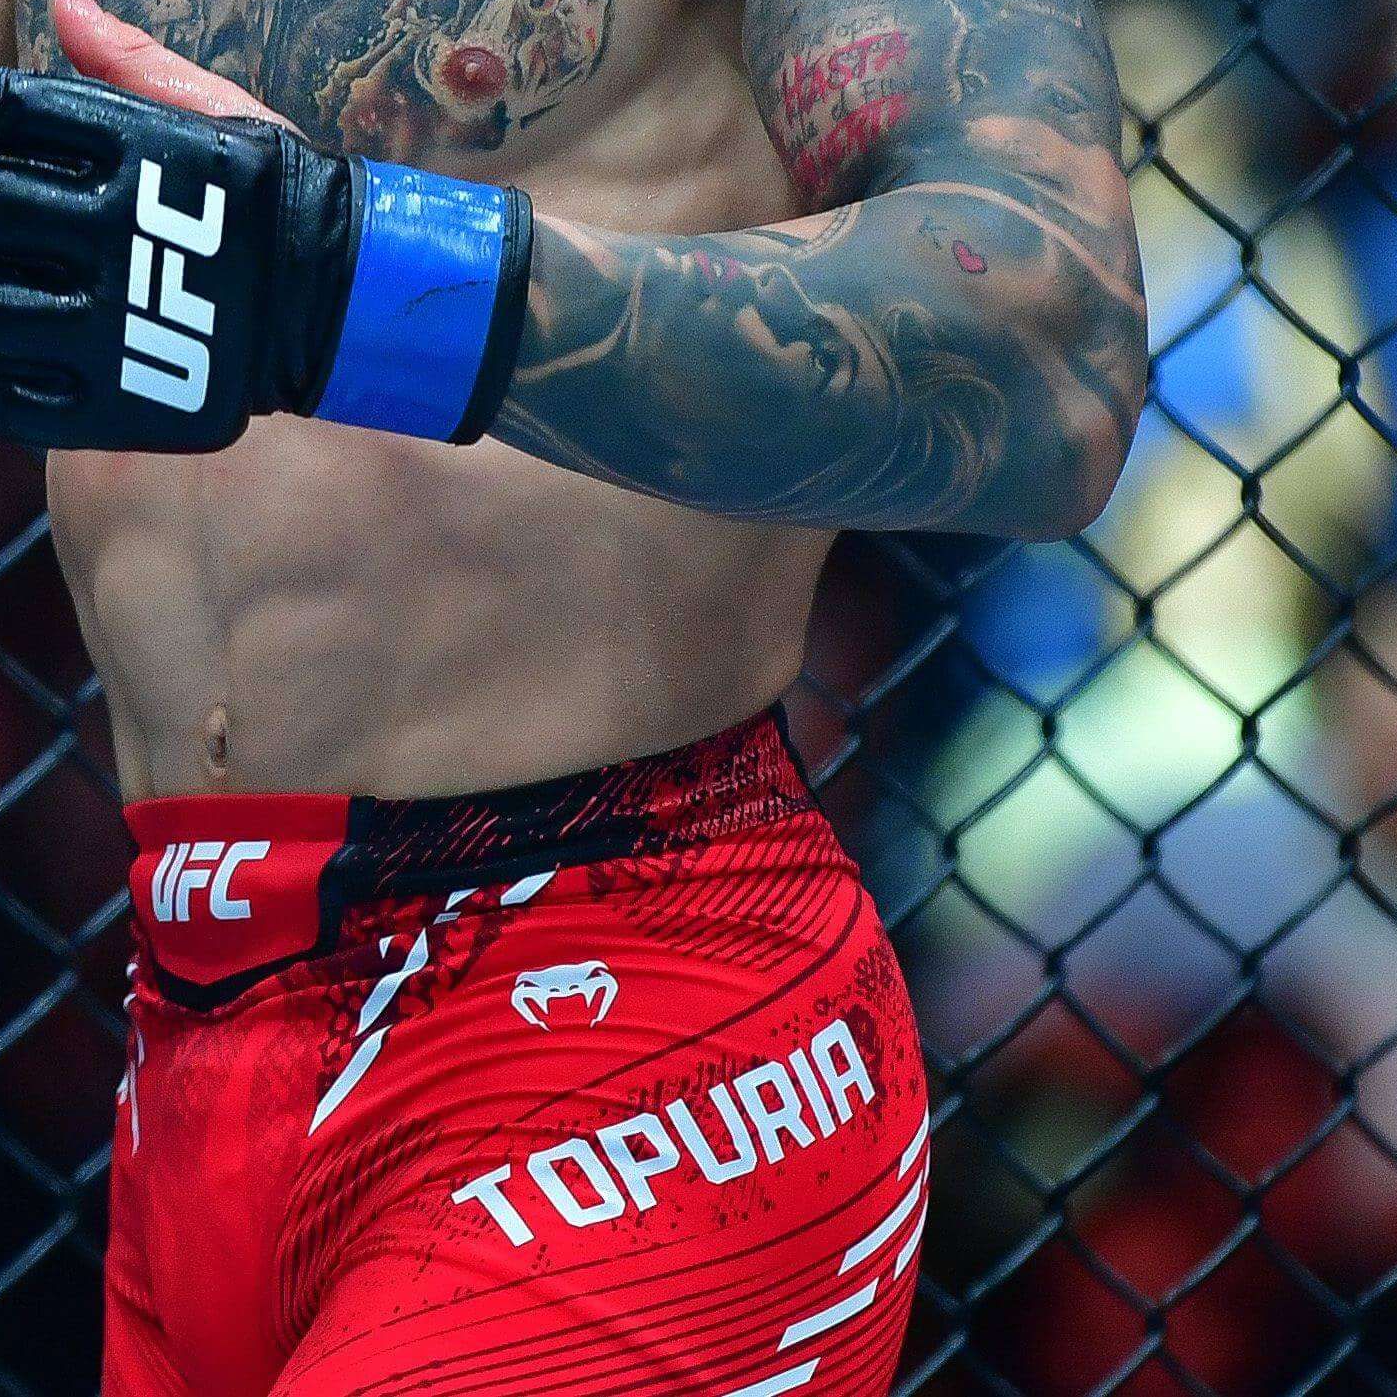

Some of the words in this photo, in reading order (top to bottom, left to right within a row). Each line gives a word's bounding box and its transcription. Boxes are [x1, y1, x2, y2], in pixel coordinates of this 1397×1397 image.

[120, 158, 226, 413] UFC
[151, 840, 272, 923] UFC
[452, 1018, 876, 1246] TOPURIA
